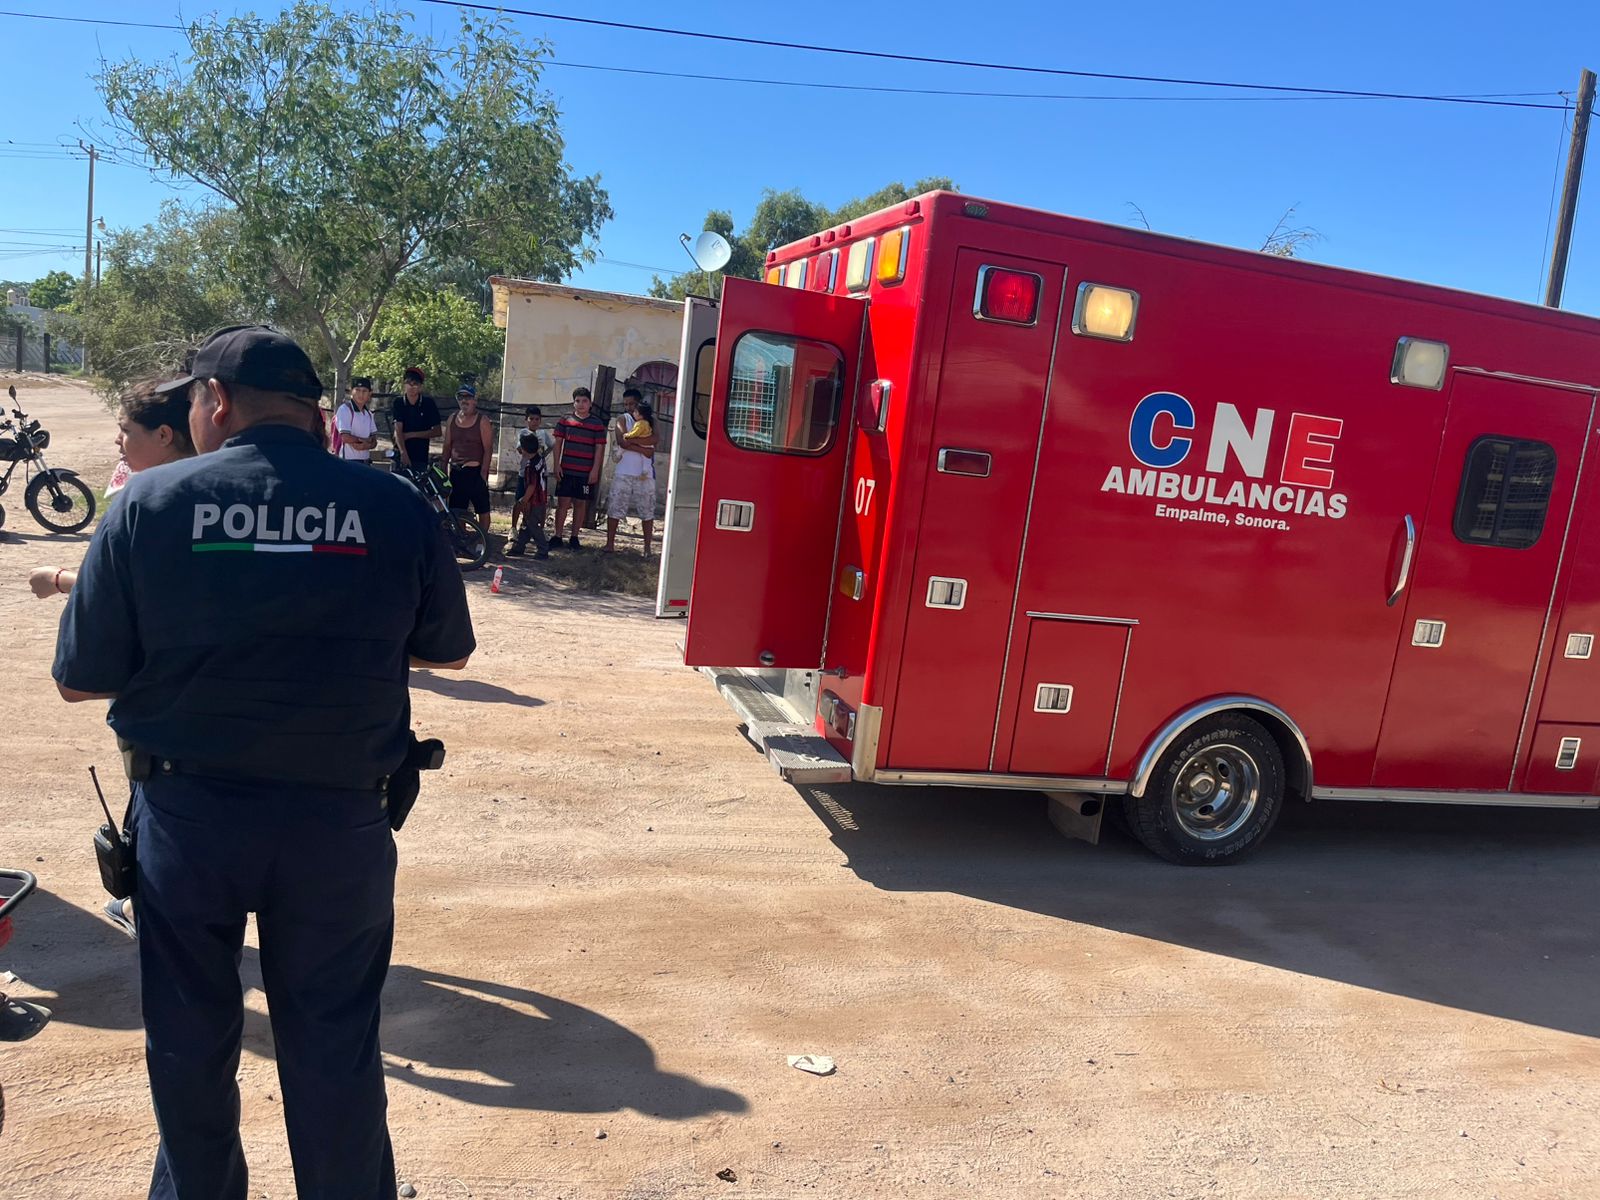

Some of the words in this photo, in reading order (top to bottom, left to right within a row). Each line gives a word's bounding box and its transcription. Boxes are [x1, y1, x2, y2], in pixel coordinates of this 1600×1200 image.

[856, 477, 875, 516] 07
[1101, 466, 1348, 519] AMBULANCIAS
[192, 502, 366, 543] POLICÍA
[1155, 504, 1230, 526] Empalme,
[1235, 513, 1291, 530] Sonora.
